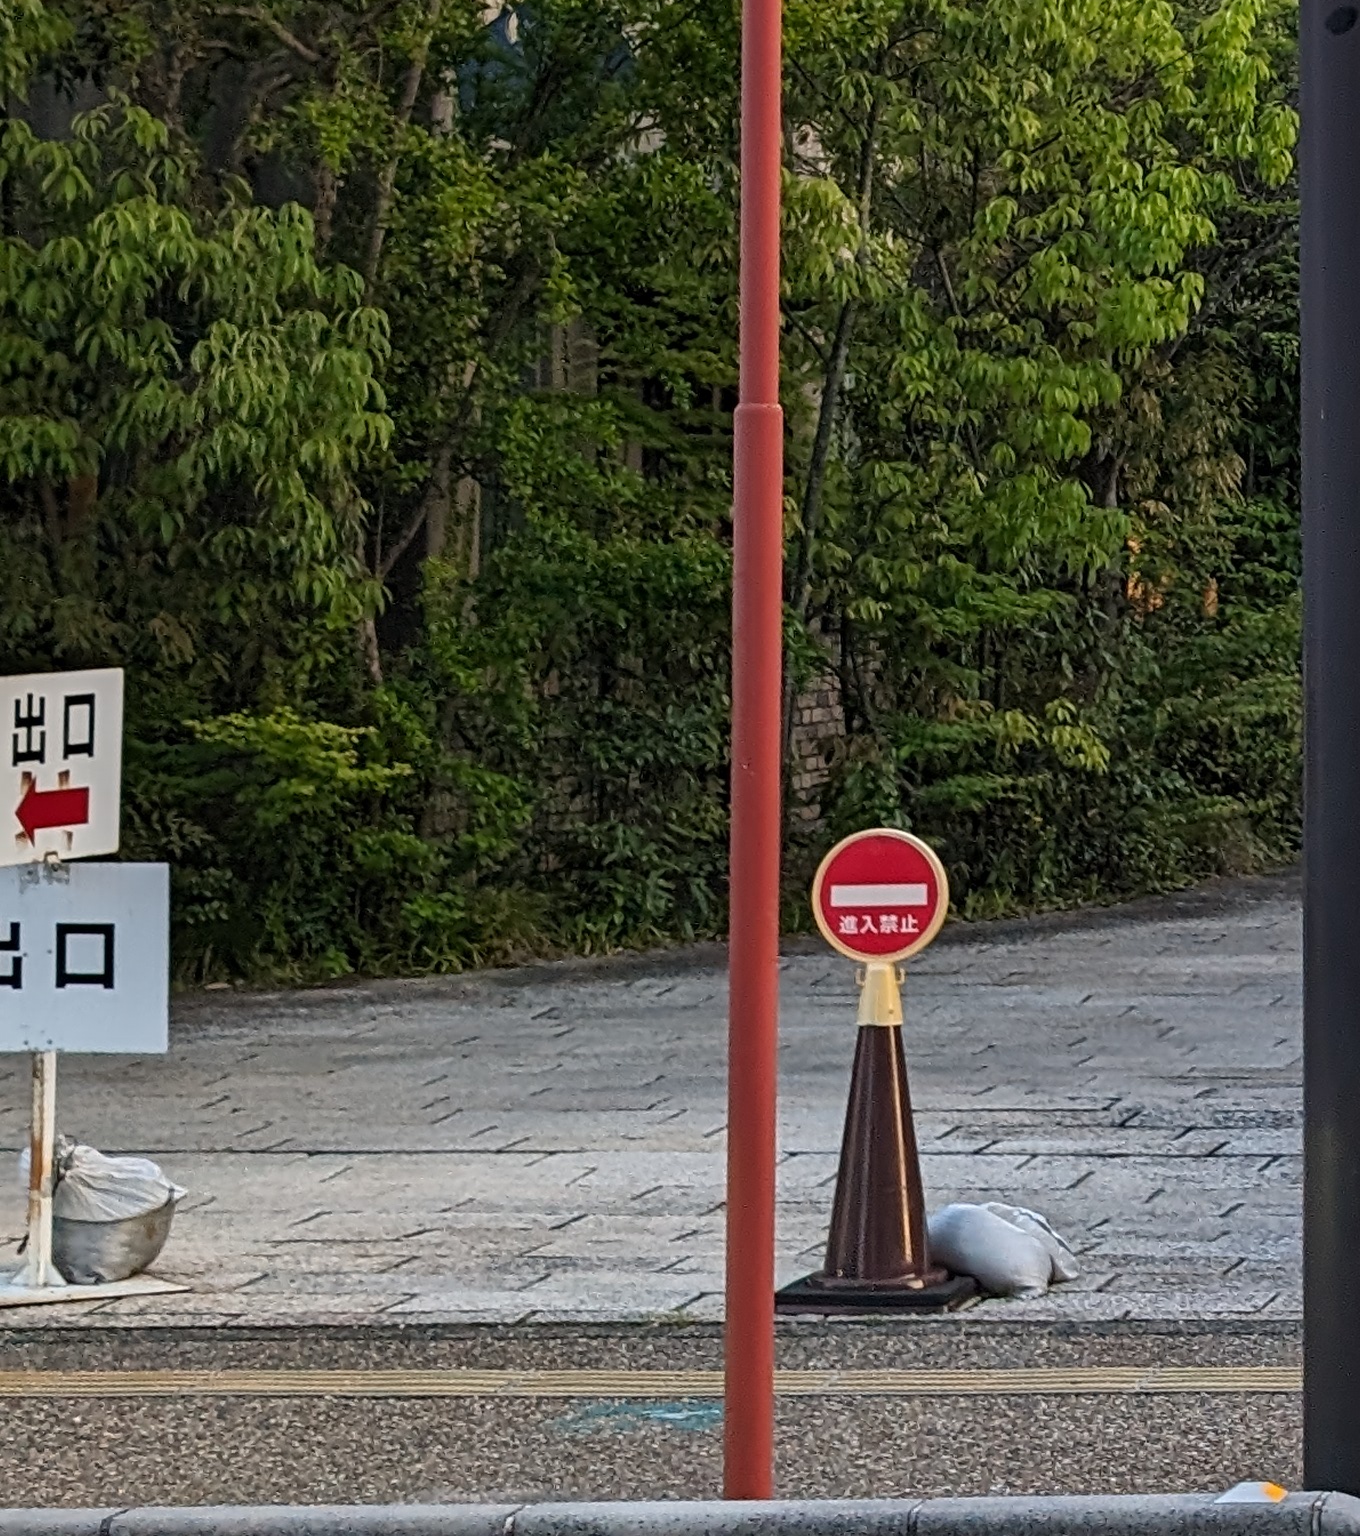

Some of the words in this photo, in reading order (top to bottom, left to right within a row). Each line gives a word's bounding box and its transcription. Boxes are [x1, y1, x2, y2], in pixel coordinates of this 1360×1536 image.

[12, 693, 95, 767] 出口
[838, 914, 920, 935] 進入禁止
